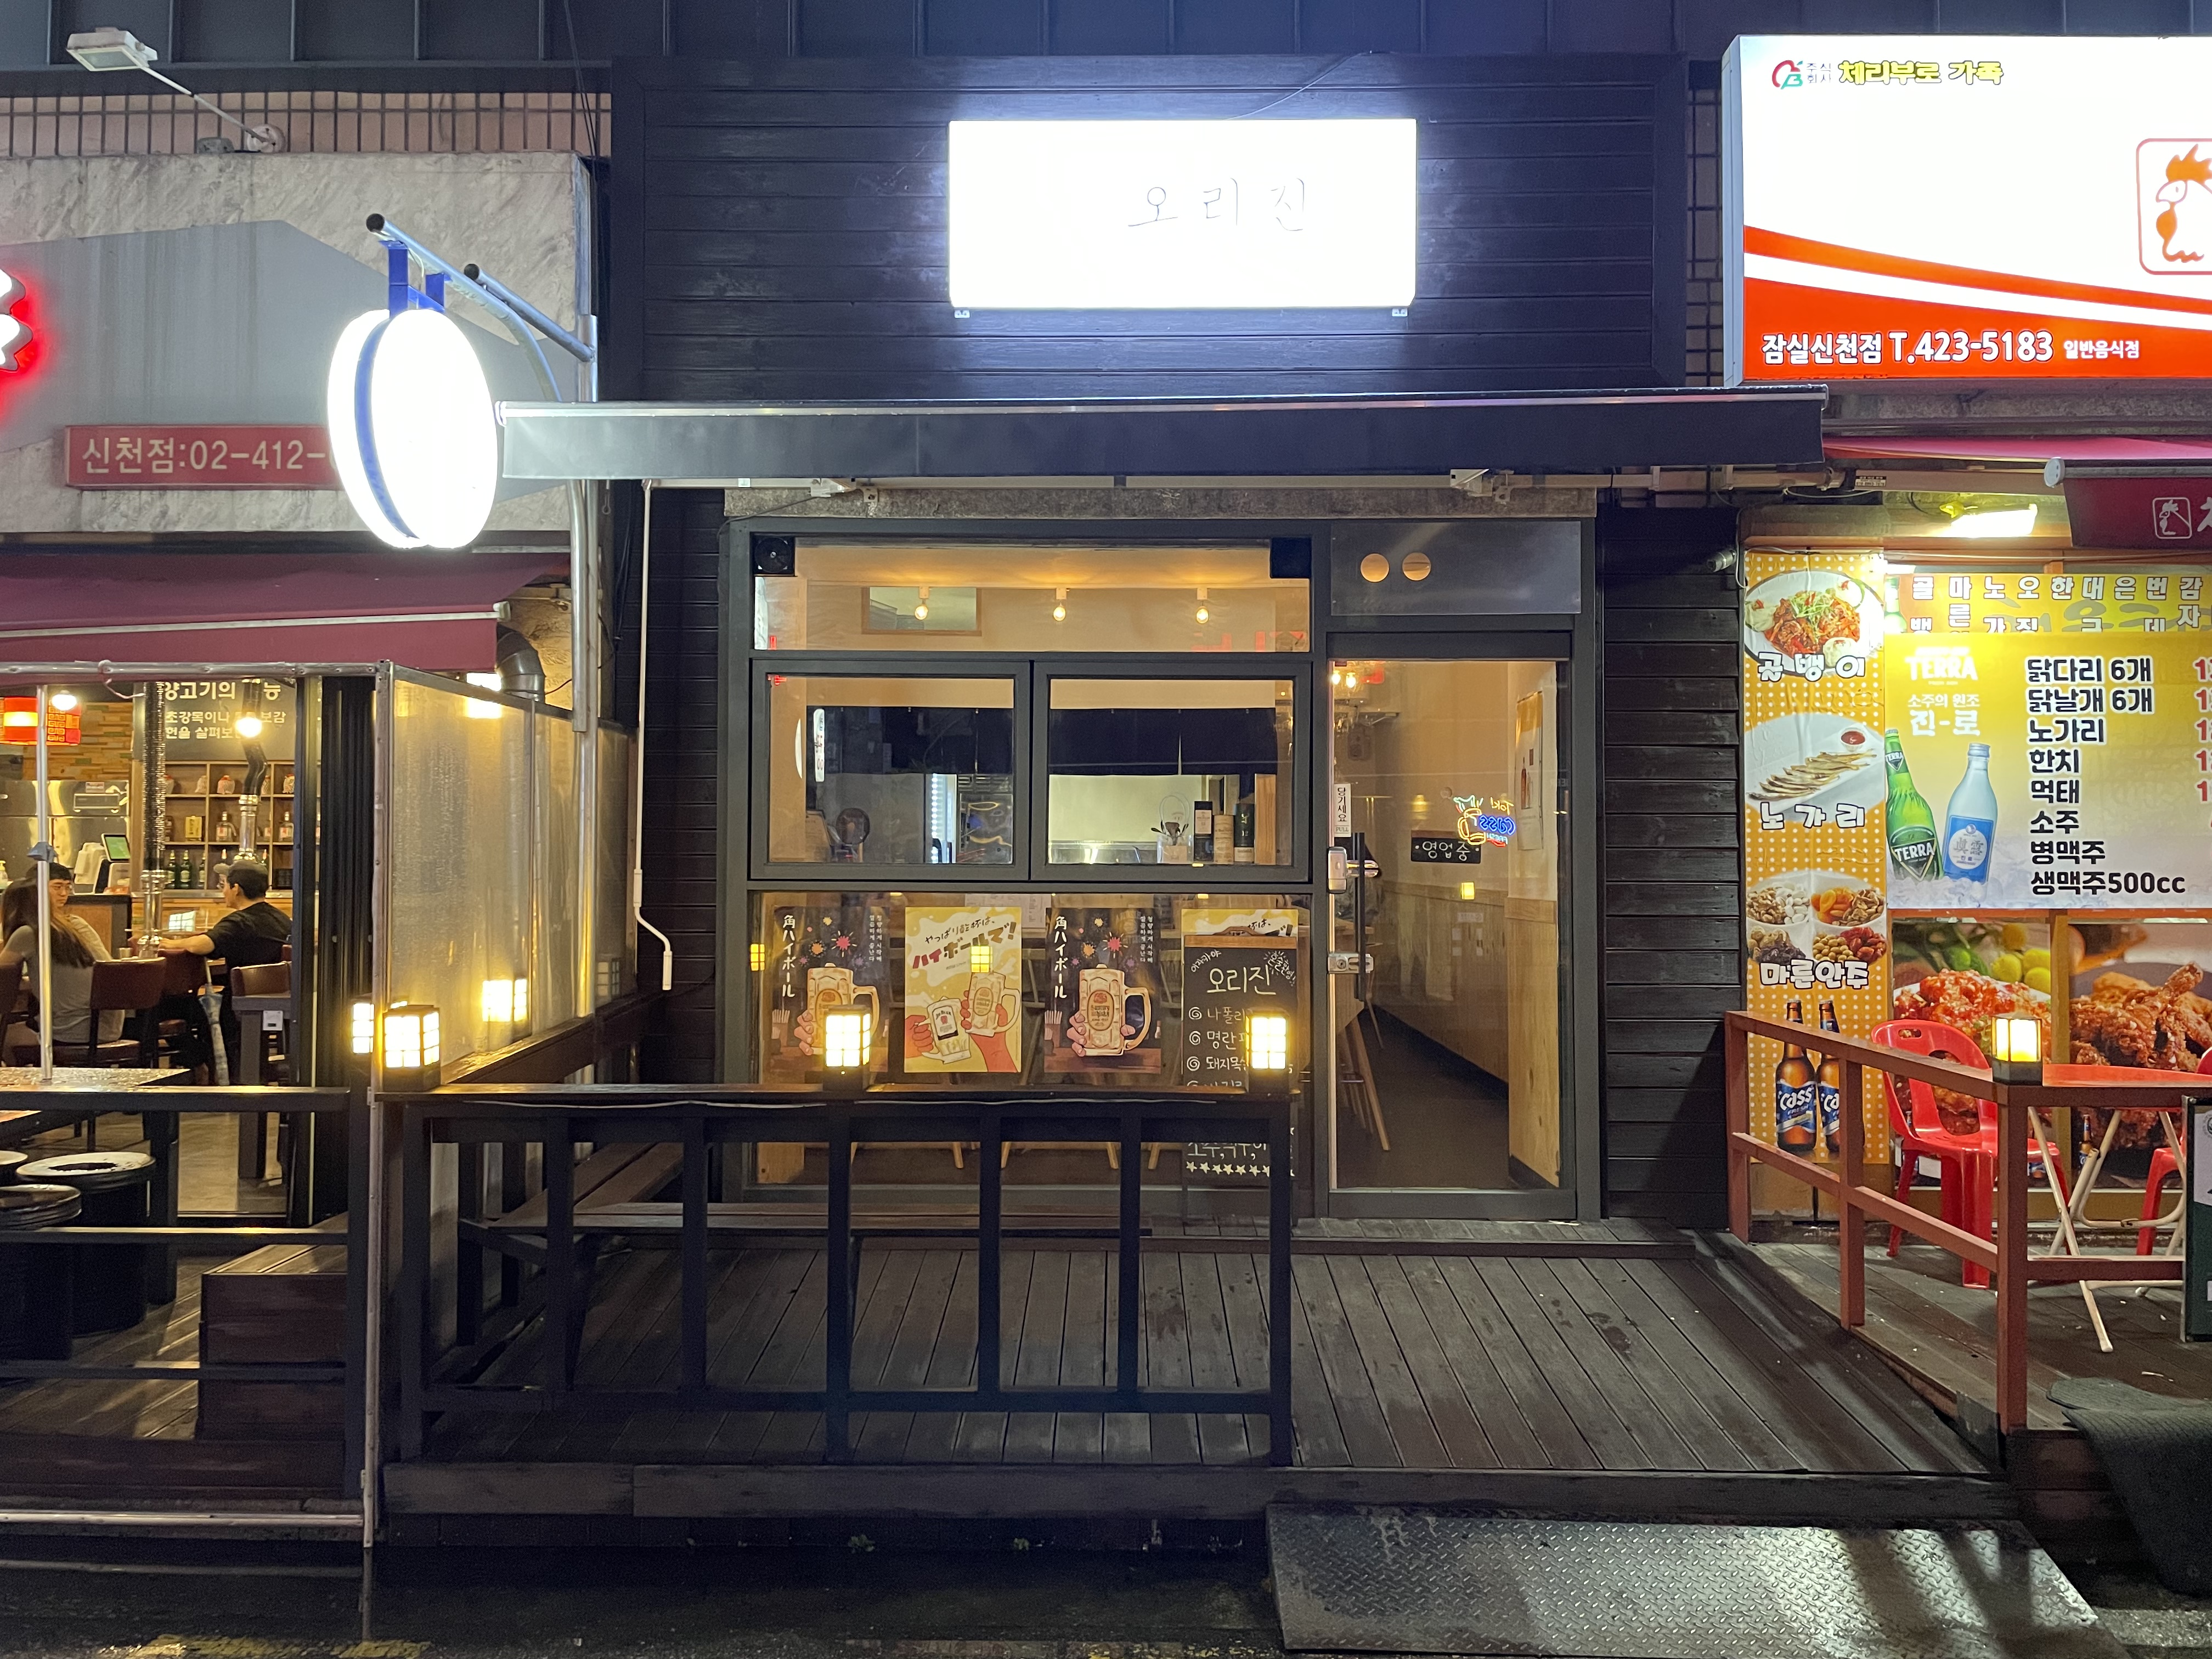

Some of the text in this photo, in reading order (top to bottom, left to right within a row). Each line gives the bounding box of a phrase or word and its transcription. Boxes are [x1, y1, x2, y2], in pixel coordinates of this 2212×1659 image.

[1838, 60, 2004, 85] 체리부로 가족
[1128, 177, 1306, 232] 오리진
[1761, 329, 2141, 365] 잠실신천점 T.423-5183 일반음식점
[82, 437, 336, 475] 신천점:02-412-
[1948, 576, 1972, 633] 마른
[1905, 657, 1978, 680] TERRA
[2028, 658, 2102, 682] 닭다리
[2111, 658, 2151, 681] 6개
[1908, 694, 1980, 707] 소주의 원조
[2028, 688, 2103, 712] 닭날개
[2112, 688, 2152, 712] 6개
[165, 711, 230, 724] 초강목이나
[165, 726, 241, 740] 헌을 살펴보
[2029, 719, 2103, 742] 노가리
[2029, 749, 2079, 772] 한치
[2032, 780, 2079, 803] 먹태
[1338, 787, 1347, 822] 당기세요
[1760, 802, 1865, 830] 노가리
[2030, 810, 2079, 833] 소주
[1894, 843, 1935, 862] TERRA
[2031, 840, 2105, 864] 병맥주
[2031, 871, 2185, 895] 생맥주500cc
[782, 915, 796, 997] 角ハイボール
[1054, 916, 1067, 998] 角ハイボール
[1190, 949, 1222, 973] 이자카야
[1207, 964, 1276, 995] 오리진
[1759, 958, 1869, 989] 마른안주
[1207, 1030, 1237, 1050] 명란
